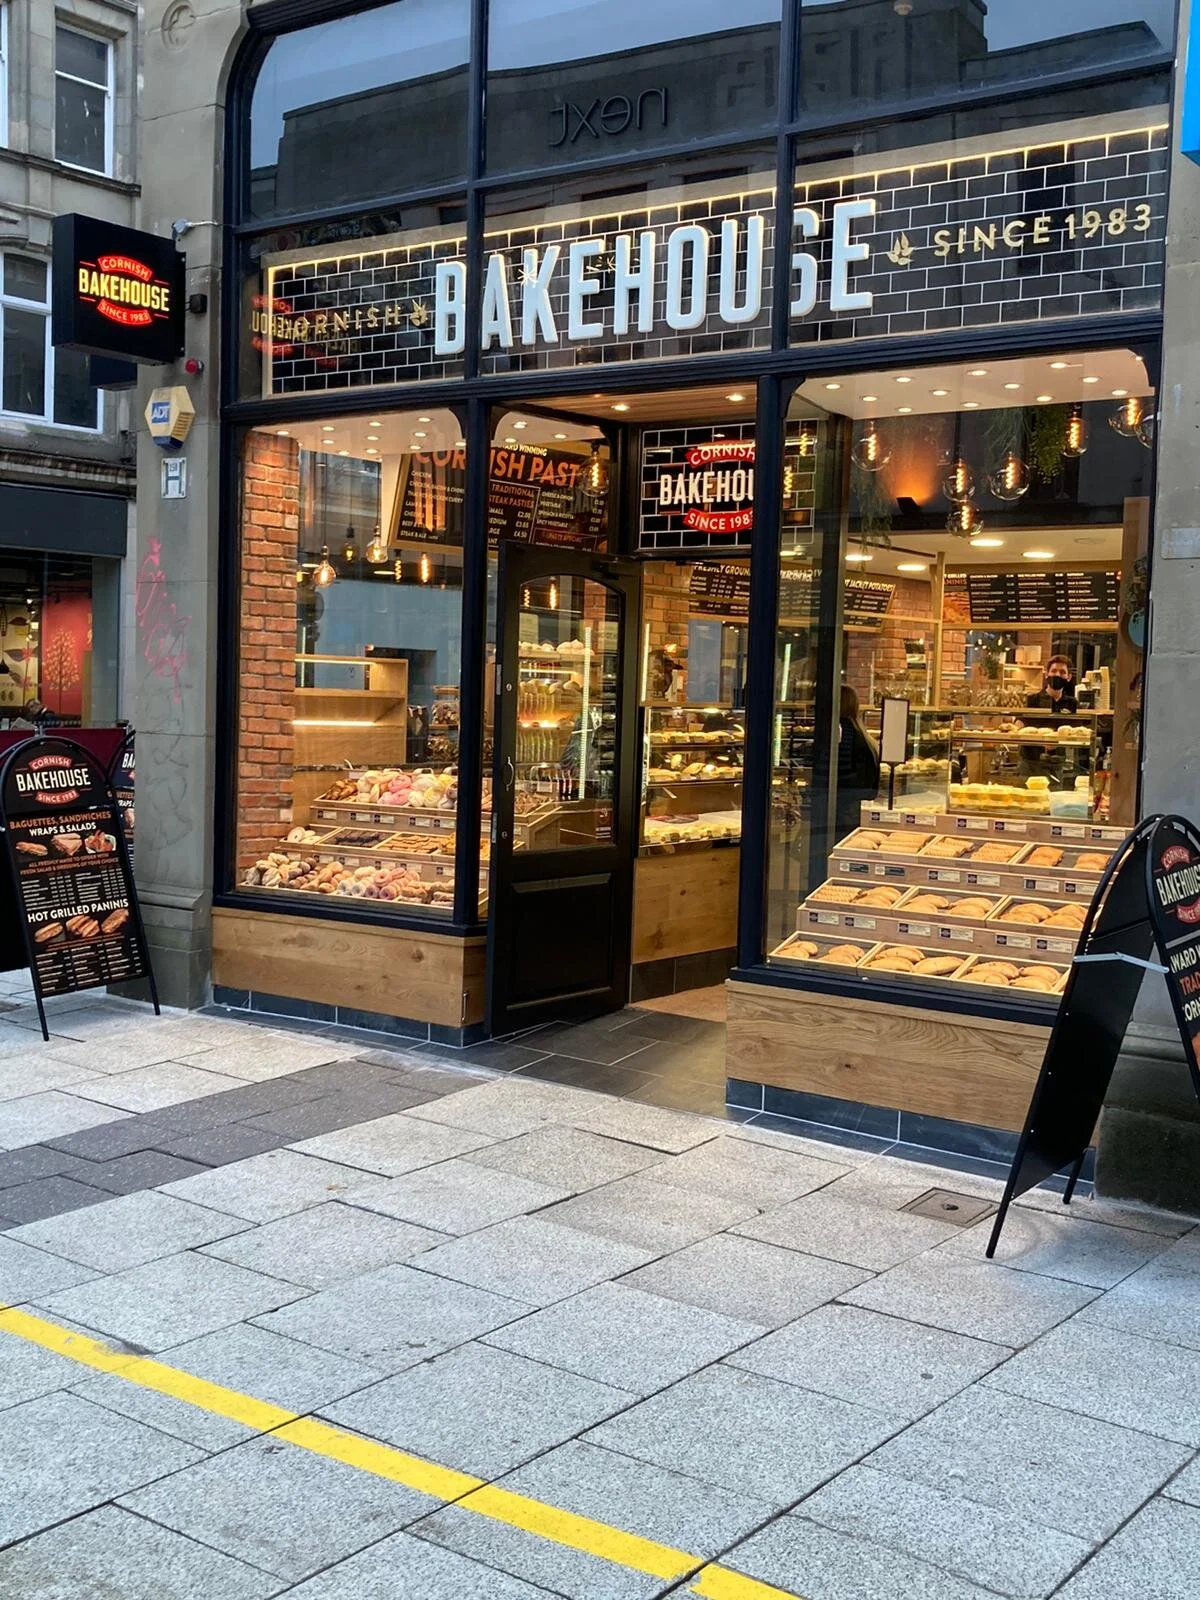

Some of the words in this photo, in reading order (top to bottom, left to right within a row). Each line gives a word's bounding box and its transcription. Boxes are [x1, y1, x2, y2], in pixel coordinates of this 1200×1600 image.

[933, 216, 1051, 257] SINCE
[1064, 203, 1151, 240] 1983
[103, 258, 149, 279] CORNISH
[435, 198, 877, 356] BAKEHOUSE
[78, 268, 170, 312] BAKEHOUSE
[100, 303, 127, 320] SINCE
[130, 311, 149, 321] 1983
[152, 405, 170, 420] ADT
[519, 445, 548, 457] WINNING
[530, 456, 580, 488] PAST
[491, 484, 535, 498] TRADITIONAL
[660, 469, 754, 506] BAKEHOU
[509, 496, 535, 509] PASTIES
[688, 513, 726, 530] SINCE
[725, 565, 751, 577] GROUN
[32, 757, 70, 769] CORNISH
[16, 768, 91, 792] BAKEHOUSE
[38, 793, 60, 803] SINCE
[9, 816, 59, 829] BAGUETTES,
[59, 811, 112, 823] SANDWICHES
[29, 825, 58, 837] WRAPS
[60, 825, 65, 833] &
[66, 822, 97, 832] SALADS
[1156, 864, 1200, 906] BAKEHOUS
[27, 911, 48, 923] HOT
[50, 905, 90, 919] GRILLED
[91, 898, 129, 913] PANINIS
[1170, 947, 1197, 974] WARD
